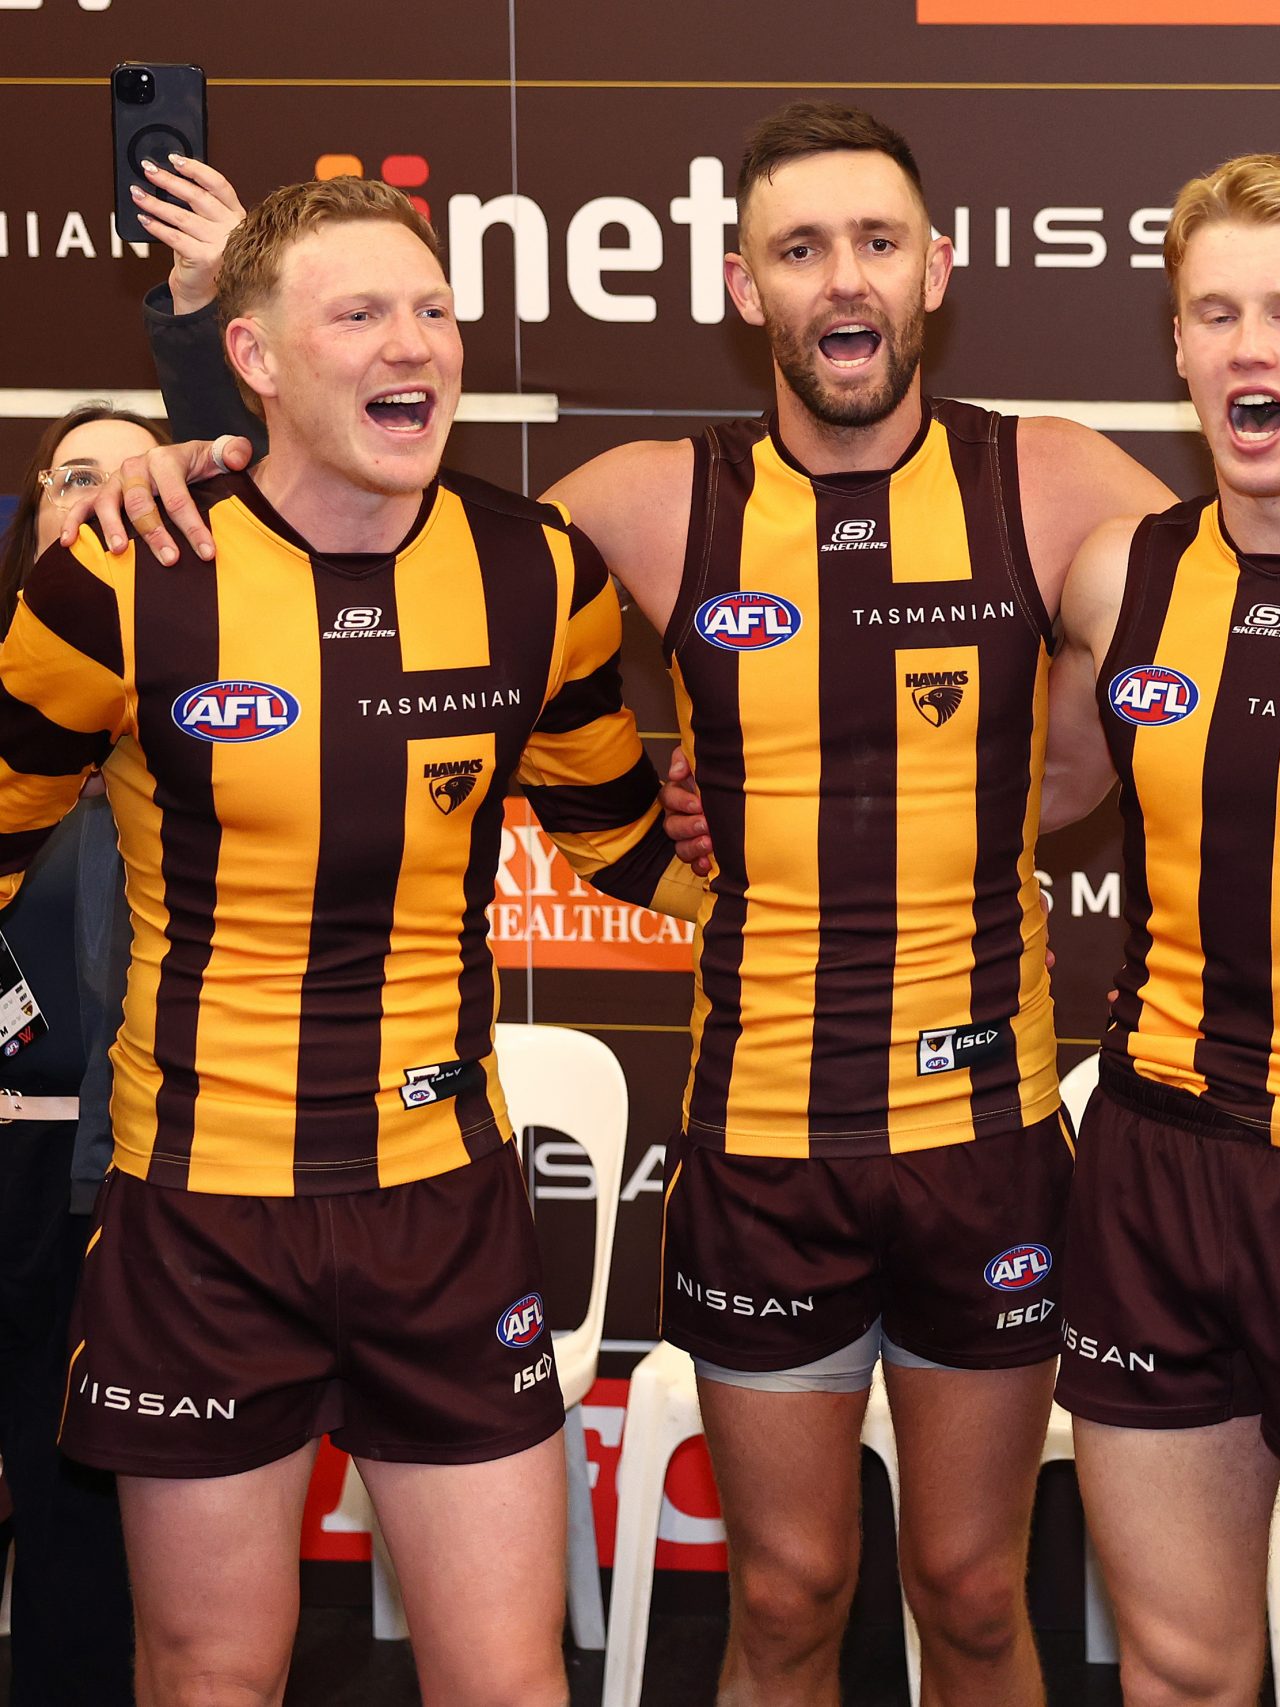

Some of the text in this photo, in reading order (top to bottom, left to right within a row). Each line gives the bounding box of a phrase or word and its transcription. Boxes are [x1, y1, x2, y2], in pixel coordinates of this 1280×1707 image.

[315, 154, 739, 324] net
[820, 540, 888, 552] SKECHERS
[704, 606, 792, 635] AFL
[853, 601, 1016, 626] TASMANIAN
[322, 629, 397, 640] SKECHERS
[905, 670, 968, 688] HAWKS
[358, 689, 521, 716] TASMANIAN
[1114, 679, 1188, 714] AFL
[180, 696, 289, 727] AFL
[424, 758, 483, 779] HAWKS
[487, 903, 699, 944] EALTHCA
[956, 1032, 986, 1050] ISC
[928, 1059, 947, 1068] AFL
[993, 1252, 1048, 1285] AFL
[677, 1271, 814, 1317] NISSAN
[505, 1301, 543, 1343] AFL
[996, 1304, 1043, 1329] ISC
[1061, 1318, 1155, 1373] ISSAN
[513, 1357, 547, 1394] ISC
